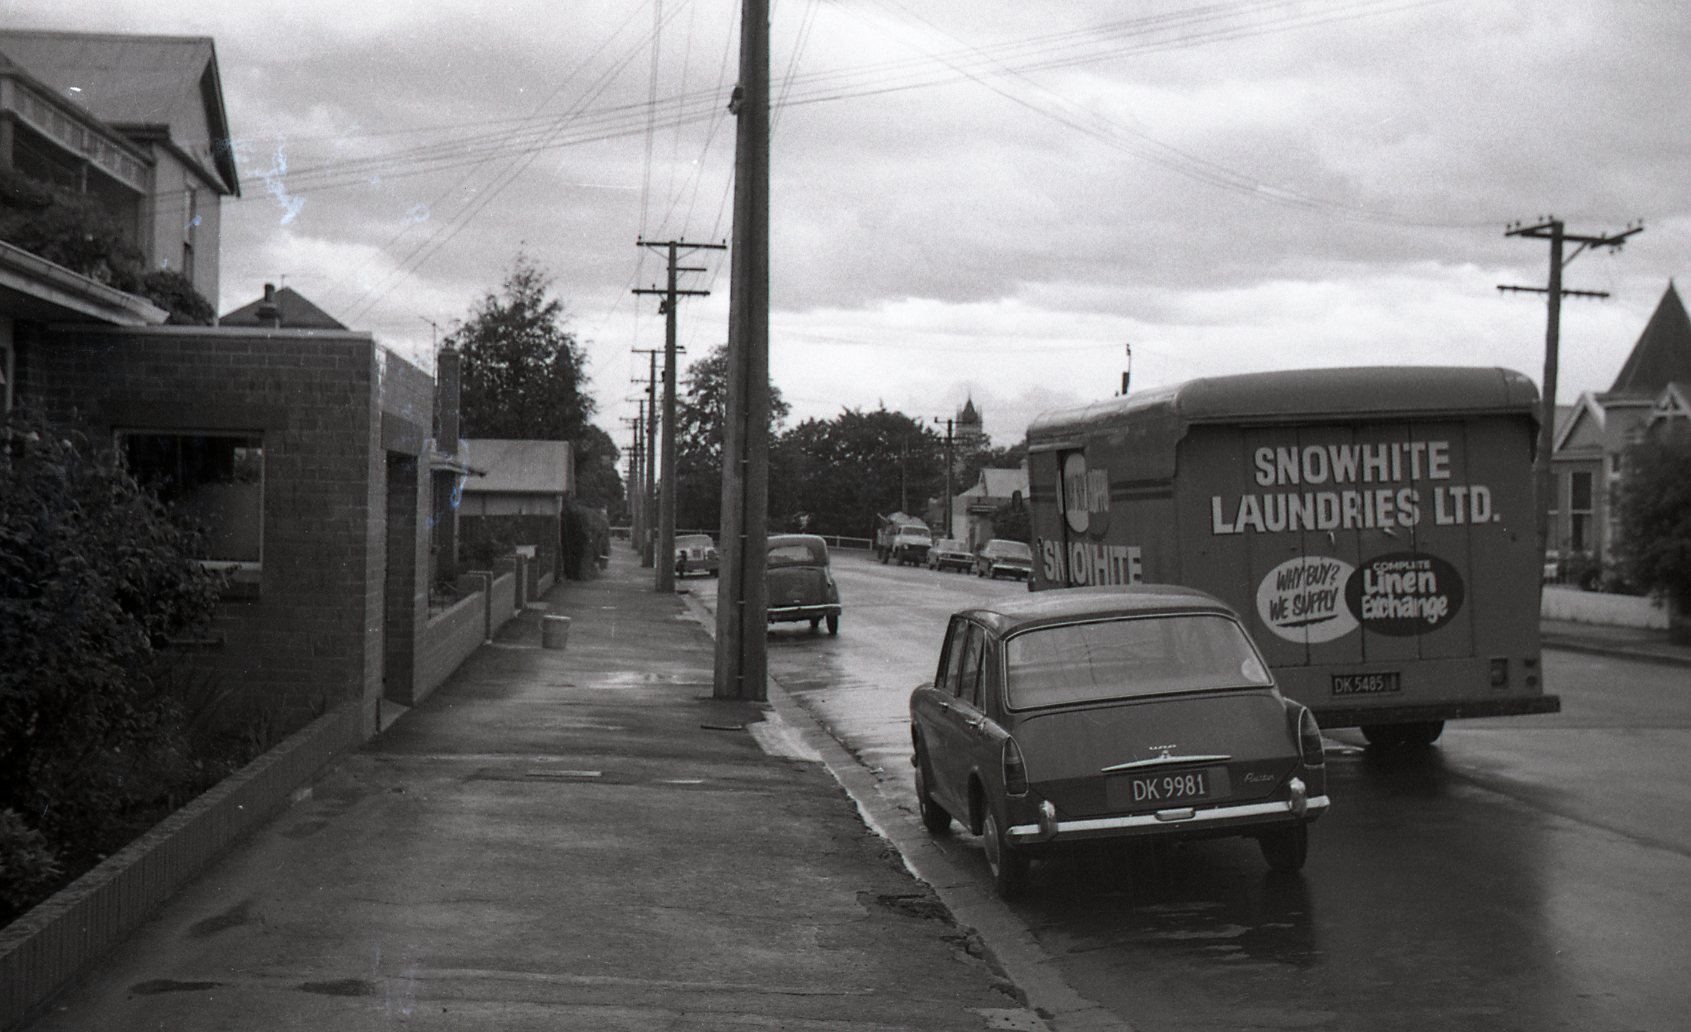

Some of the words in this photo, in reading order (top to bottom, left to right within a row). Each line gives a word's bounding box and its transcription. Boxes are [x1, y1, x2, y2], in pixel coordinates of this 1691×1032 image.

[1255, 441, 1451, 487] SNOWHITE
[1211, 488, 1421, 534] LAUNDRIES
[1433, 485, 1500, 525] LTD.
[1276, 565, 1305, 591] WHY
[1363, 569, 1436, 595] Linen
[1269, 596, 1289, 621] WE
[1292, 587, 1339, 616] SUPPLY
[1361, 594, 1449, 623] Exchange
